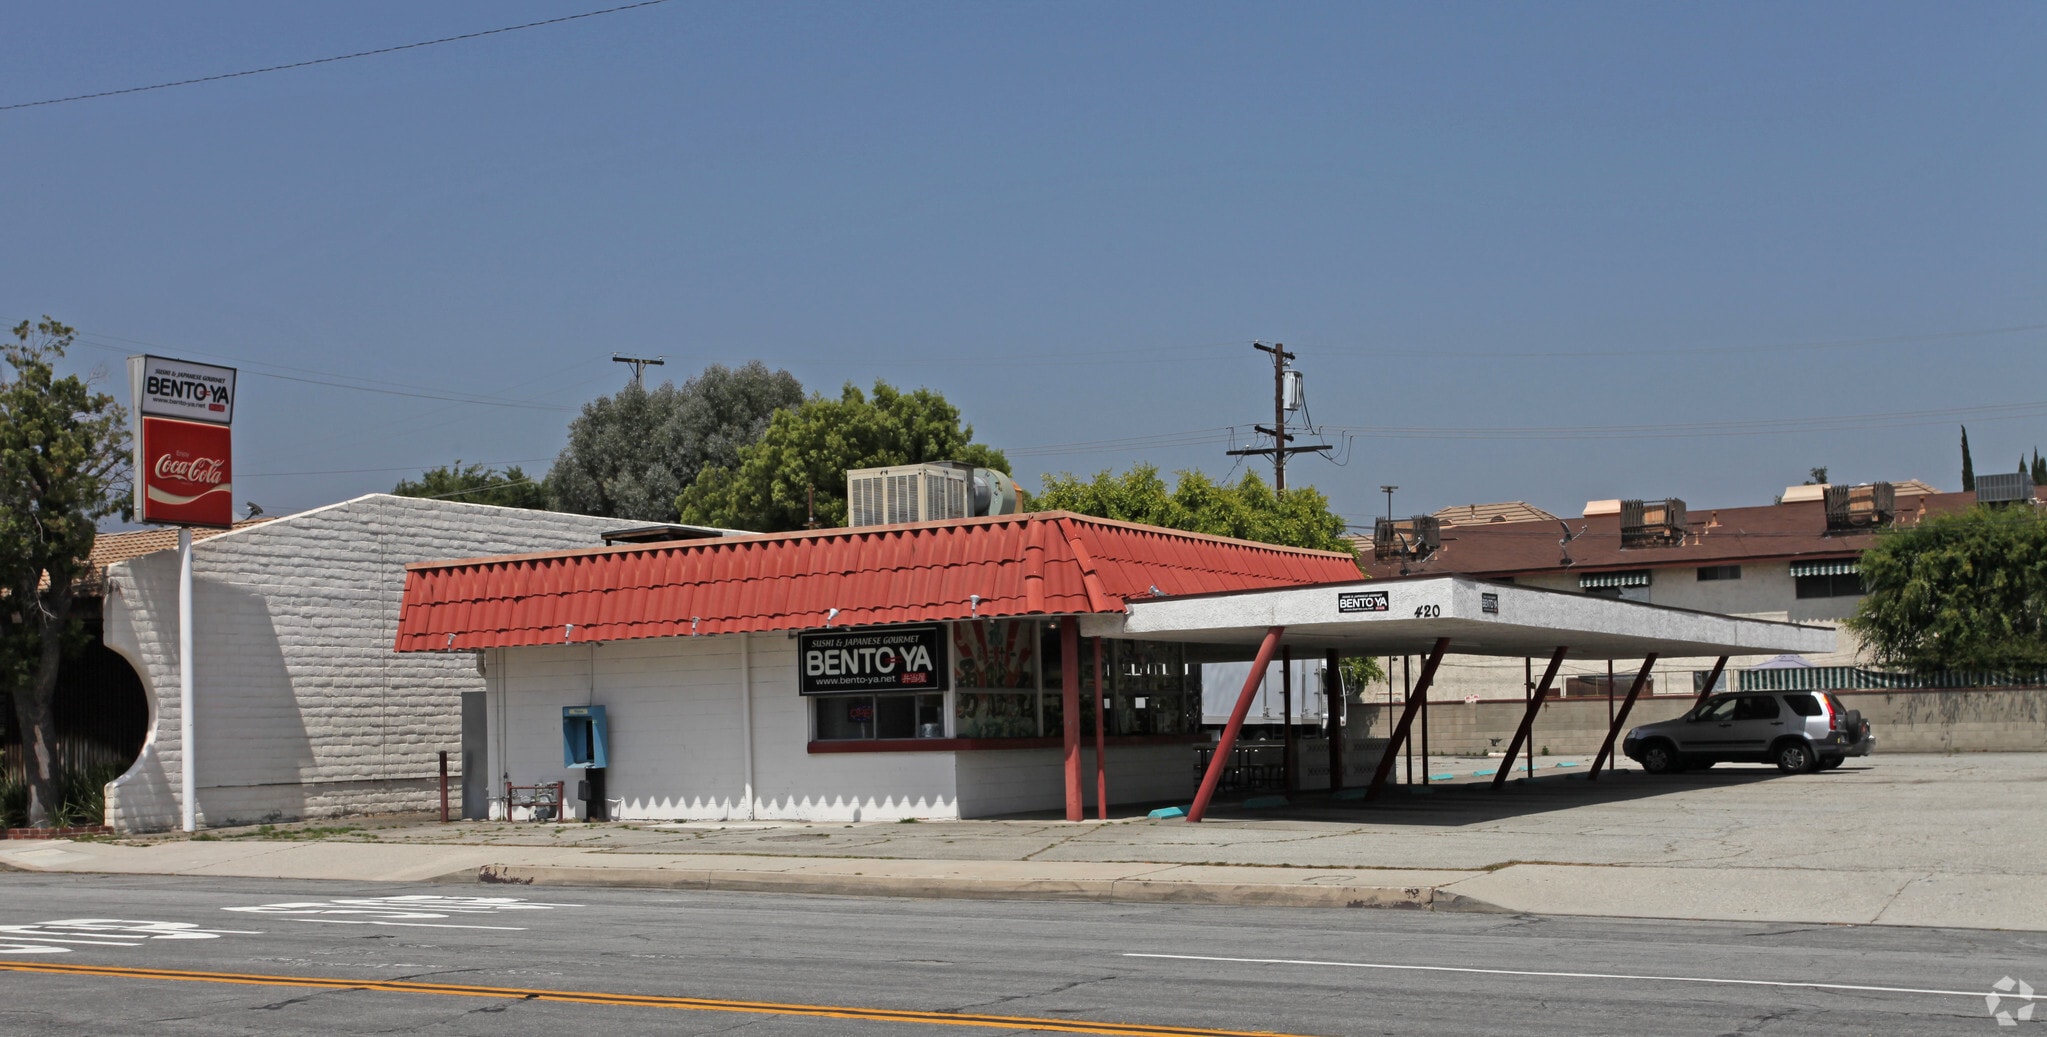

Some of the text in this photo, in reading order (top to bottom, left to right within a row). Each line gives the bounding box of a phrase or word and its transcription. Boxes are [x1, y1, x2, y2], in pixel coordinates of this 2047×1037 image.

[177, 372, 202, 380] JAPANESE
[1414, 604, 1441, 618] 420
[812, 635, 920, 648] SUSHI & JAPANESE GOURMET
[816, 675, 896, 685] www.bento-ya.net
